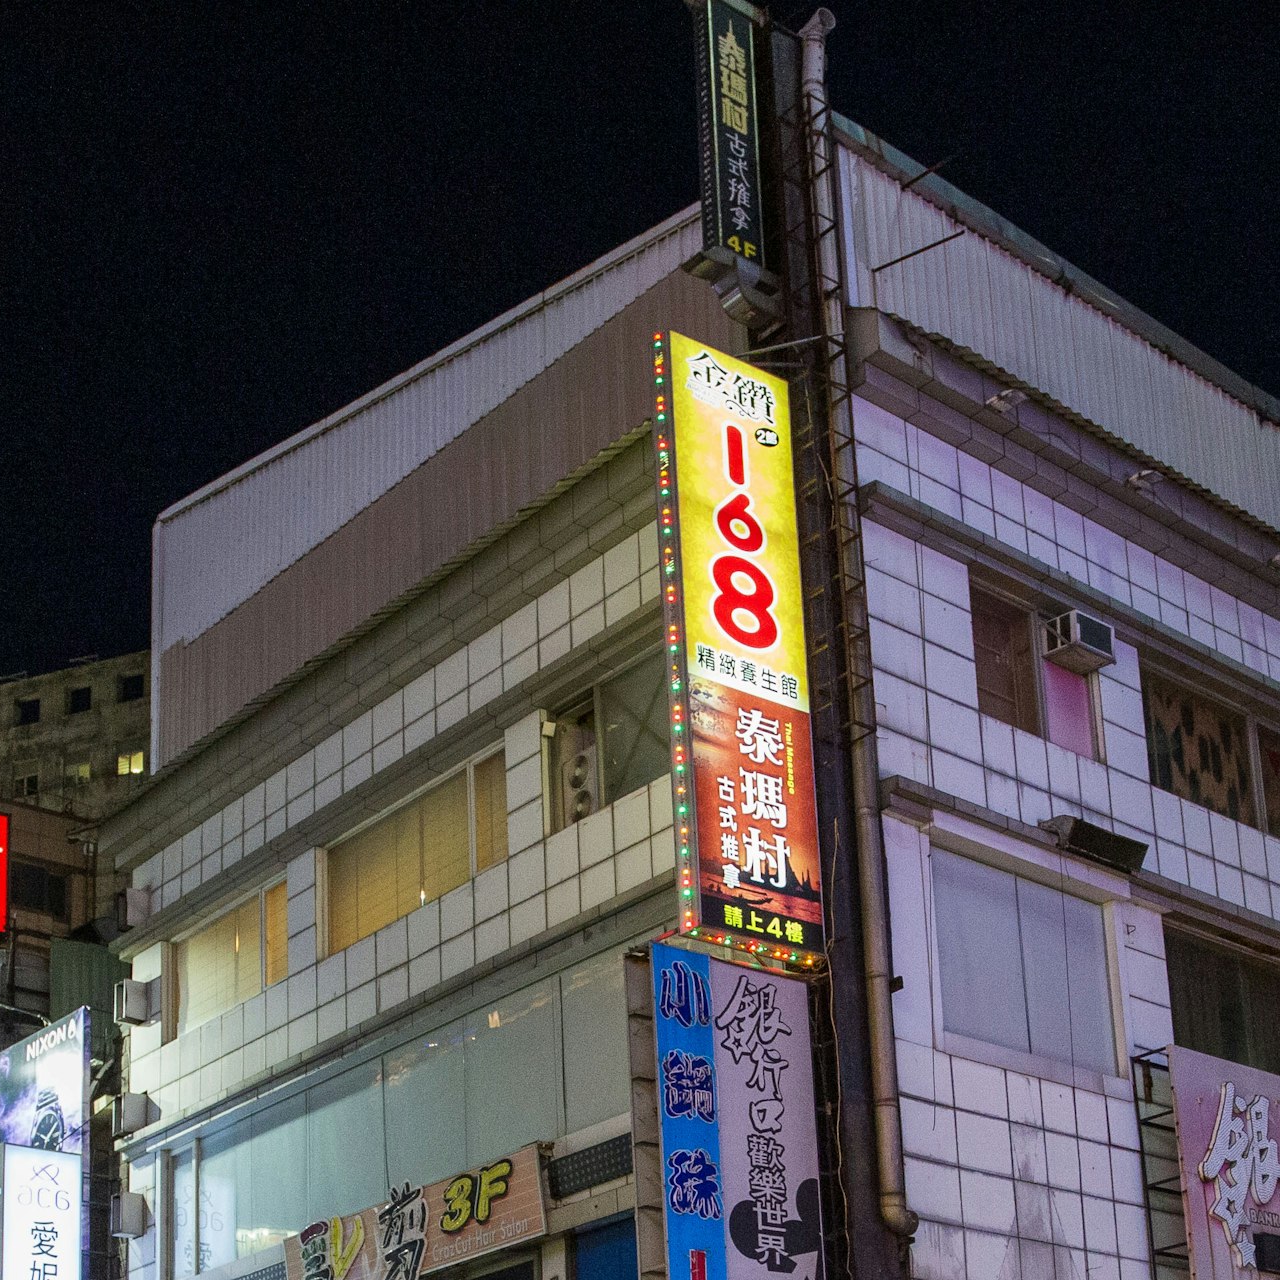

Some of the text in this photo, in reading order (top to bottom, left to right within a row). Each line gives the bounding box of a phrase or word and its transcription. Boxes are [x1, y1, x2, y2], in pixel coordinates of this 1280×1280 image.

[718, 19, 749, 136] 泰瑪村
[727, 235, 757, 257] 4F
[712, 423, 778, 650] 168
[696, 645, 799, 700] 精緻養生館
[734, 707, 791, 889] 泰瑪村
[716, 775, 742, 889] 古式推拿
[723, 903, 805, 945] 請上4樓
[26, 1025, 67, 1062] NIXON
[439, 1157, 514, 1234] 3F
[1249, 1208, 1280, 1229] BANK
[475, 1228, 497, 1248] Hair
[500, 1217, 529, 1242] Salon
